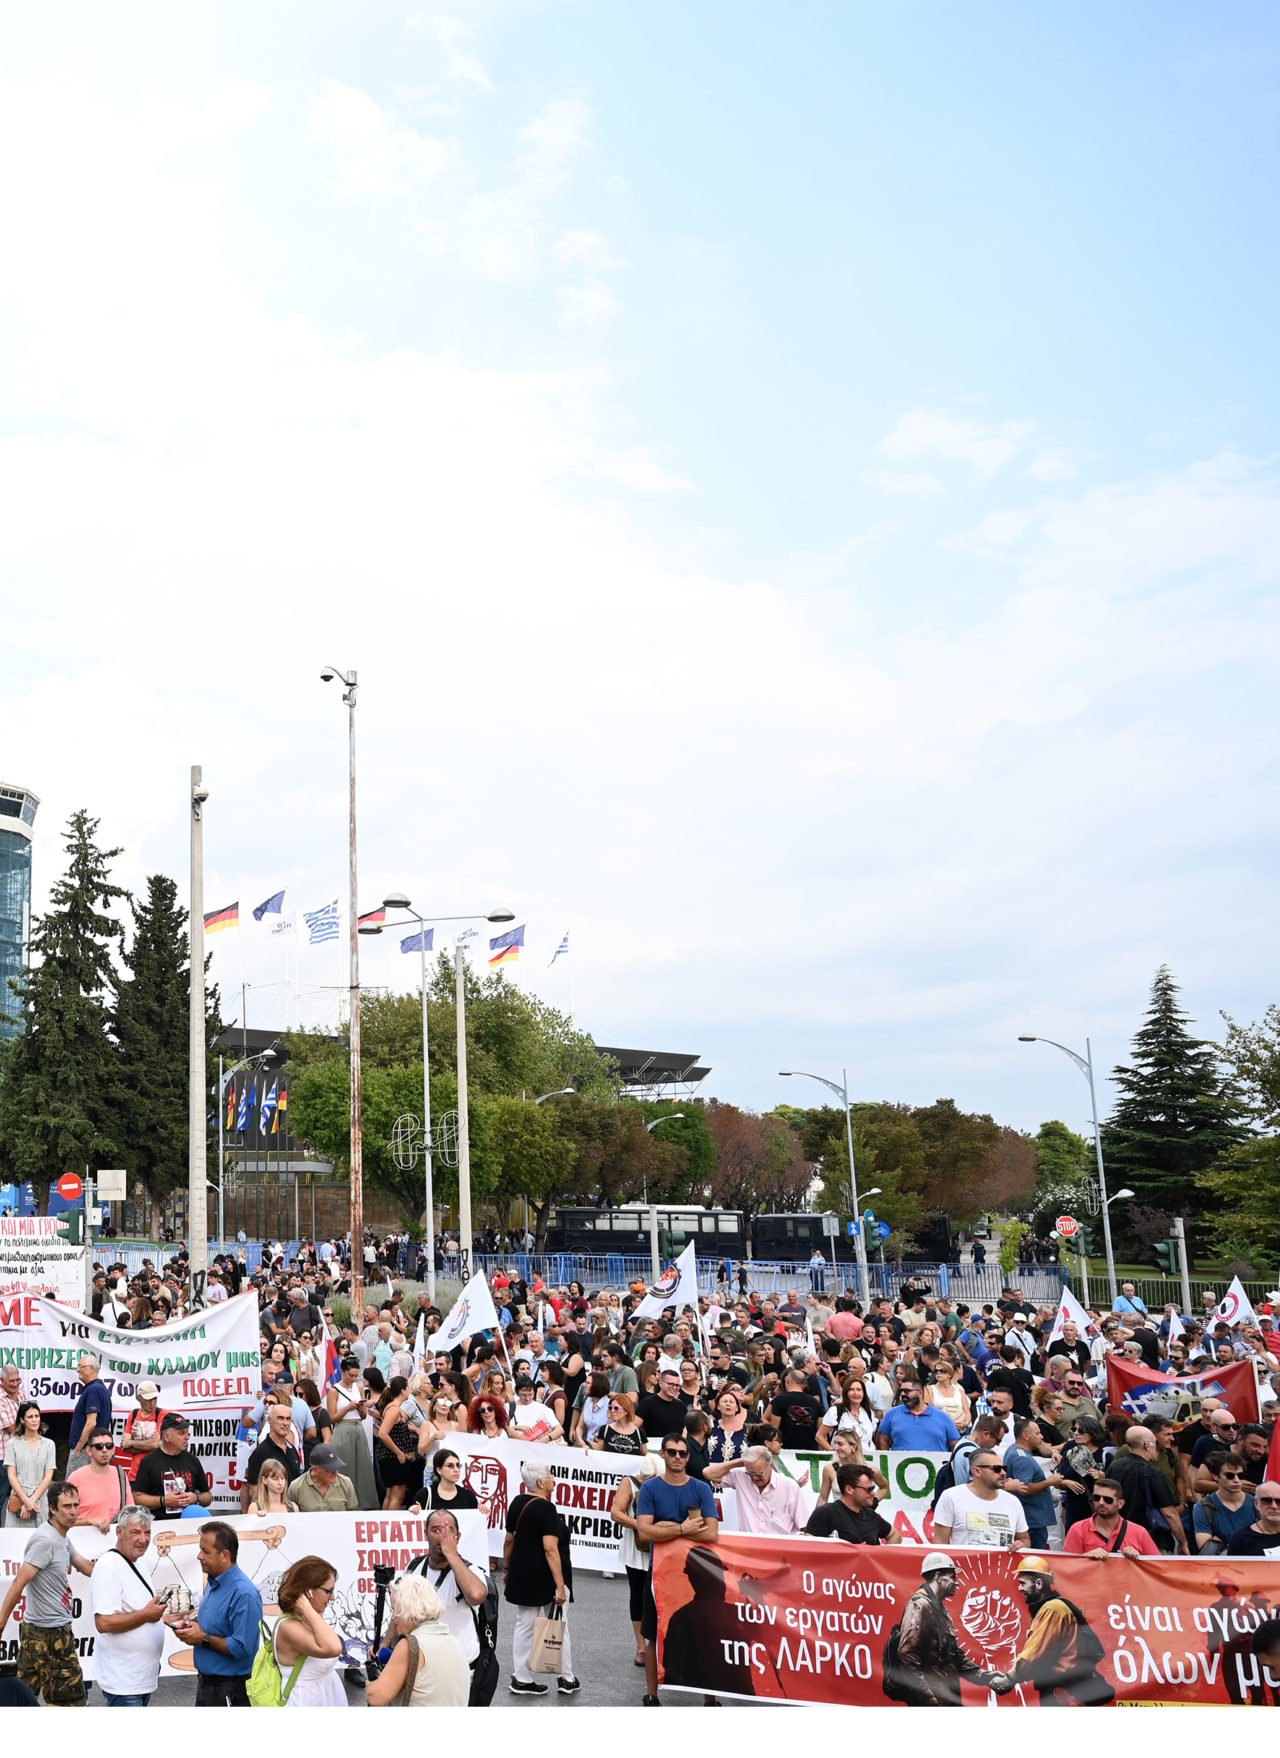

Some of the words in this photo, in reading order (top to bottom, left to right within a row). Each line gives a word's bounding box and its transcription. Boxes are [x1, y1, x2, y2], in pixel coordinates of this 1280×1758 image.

[1, 1219, 17, 1236] ΚΑΙ
[20, 1219, 35, 1236] ΜΙΑ
[1057, 1221, 1076, 1231] STOP
[59, 1320, 90, 1340] για
[108, 1358, 142, 1375] του
[147, 1350, 221, 1376] ΚΛΑΔΟΥ
[226, 1351, 260, 1373] μας
[30, 1377, 83, 1399] 35ωρ
[182, 1376, 253, 1398] Π.Ο.Ε.Ε.Π.
[193, 1418, 241, 1437] ΜΙΣΘΟΥ
[571, 1468, 625, 1486] ΑΝΑΠΤΥΞ
[355, 1520, 428, 1543] ΕΡΓΑΤΙ
[605, 1542, 620, 1551] ΚΕΝΤ
[356, 1548, 429, 1572] ΣΩΜΑΤ
[802, 1570, 815, 1594] Ο
[822, 1573, 896, 1605] αγώνας
[735, 1601, 778, 1625] των
[785, 1605, 883, 1637] εργατών
[1107, 1593, 1184, 1633] είναι
[1192, 1597, 1280, 1642] αγών
[720, 1638, 767, 1675] της
[776, 1636, 873, 1680] ΛΑΡΚΟ
[1112, 1635, 1221, 1685] όλων
